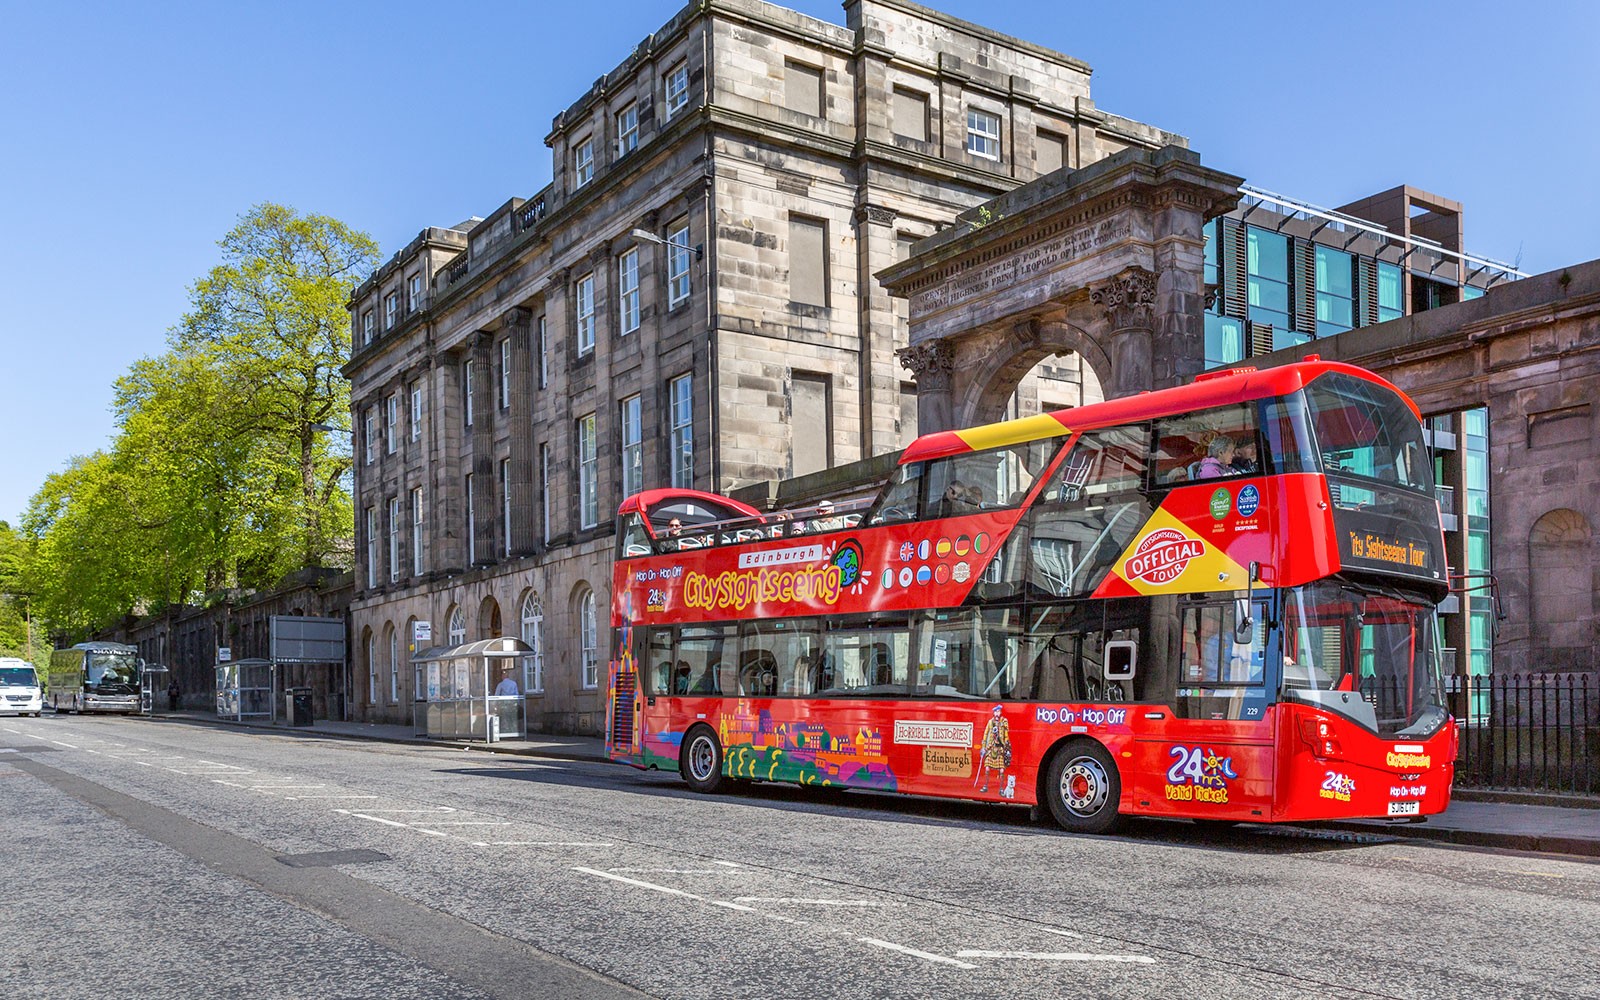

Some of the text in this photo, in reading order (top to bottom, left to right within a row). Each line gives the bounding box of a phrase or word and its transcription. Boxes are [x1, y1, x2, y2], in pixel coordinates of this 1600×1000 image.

[920, 284, 949, 302] OPENED
[952, 272, 982, 290] AUGUST
[1023, 249, 1040, 262] FOR
[1044, 241, 1061, 254] THE
[1064, 227, 1097, 246] ENTRY
[1101, 219, 1114, 231] OF
[924, 296, 949, 312] ROYAL
[950, 280, 989, 302] HIGHNESS
[991, 269, 1018, 287] PRINCE
[1021, 254, 1057, 274] LEOPOLD
[1060, 247, 1071, 259] OF
[1094, 225, 1131, 246] COBOURG
[746, 549, 815, 565] Edinburgh
[1132, 542, 1200, 575] OFFICIAL
[1366, 534, 1407, 564] Sightseeing
[1408, 543, 1425, 567] Tour
[636, 566, 682, 582] Hop On Hop Off
[1152, 563, 1183, 581] TOUR
[1036, 707, 1125, 725] Hop On Hop Off
[1247, 707, 1258, 715] 229
[898, 726, 968, 741] HORRIBLE HISTORIES
[925, 750, 970, 768] Edinburgh
[1168, 746, 1203, 783] 24
[1322, 771, 1342, 791] 24
[1165, 785, 1228, 803] Valid Ticket
